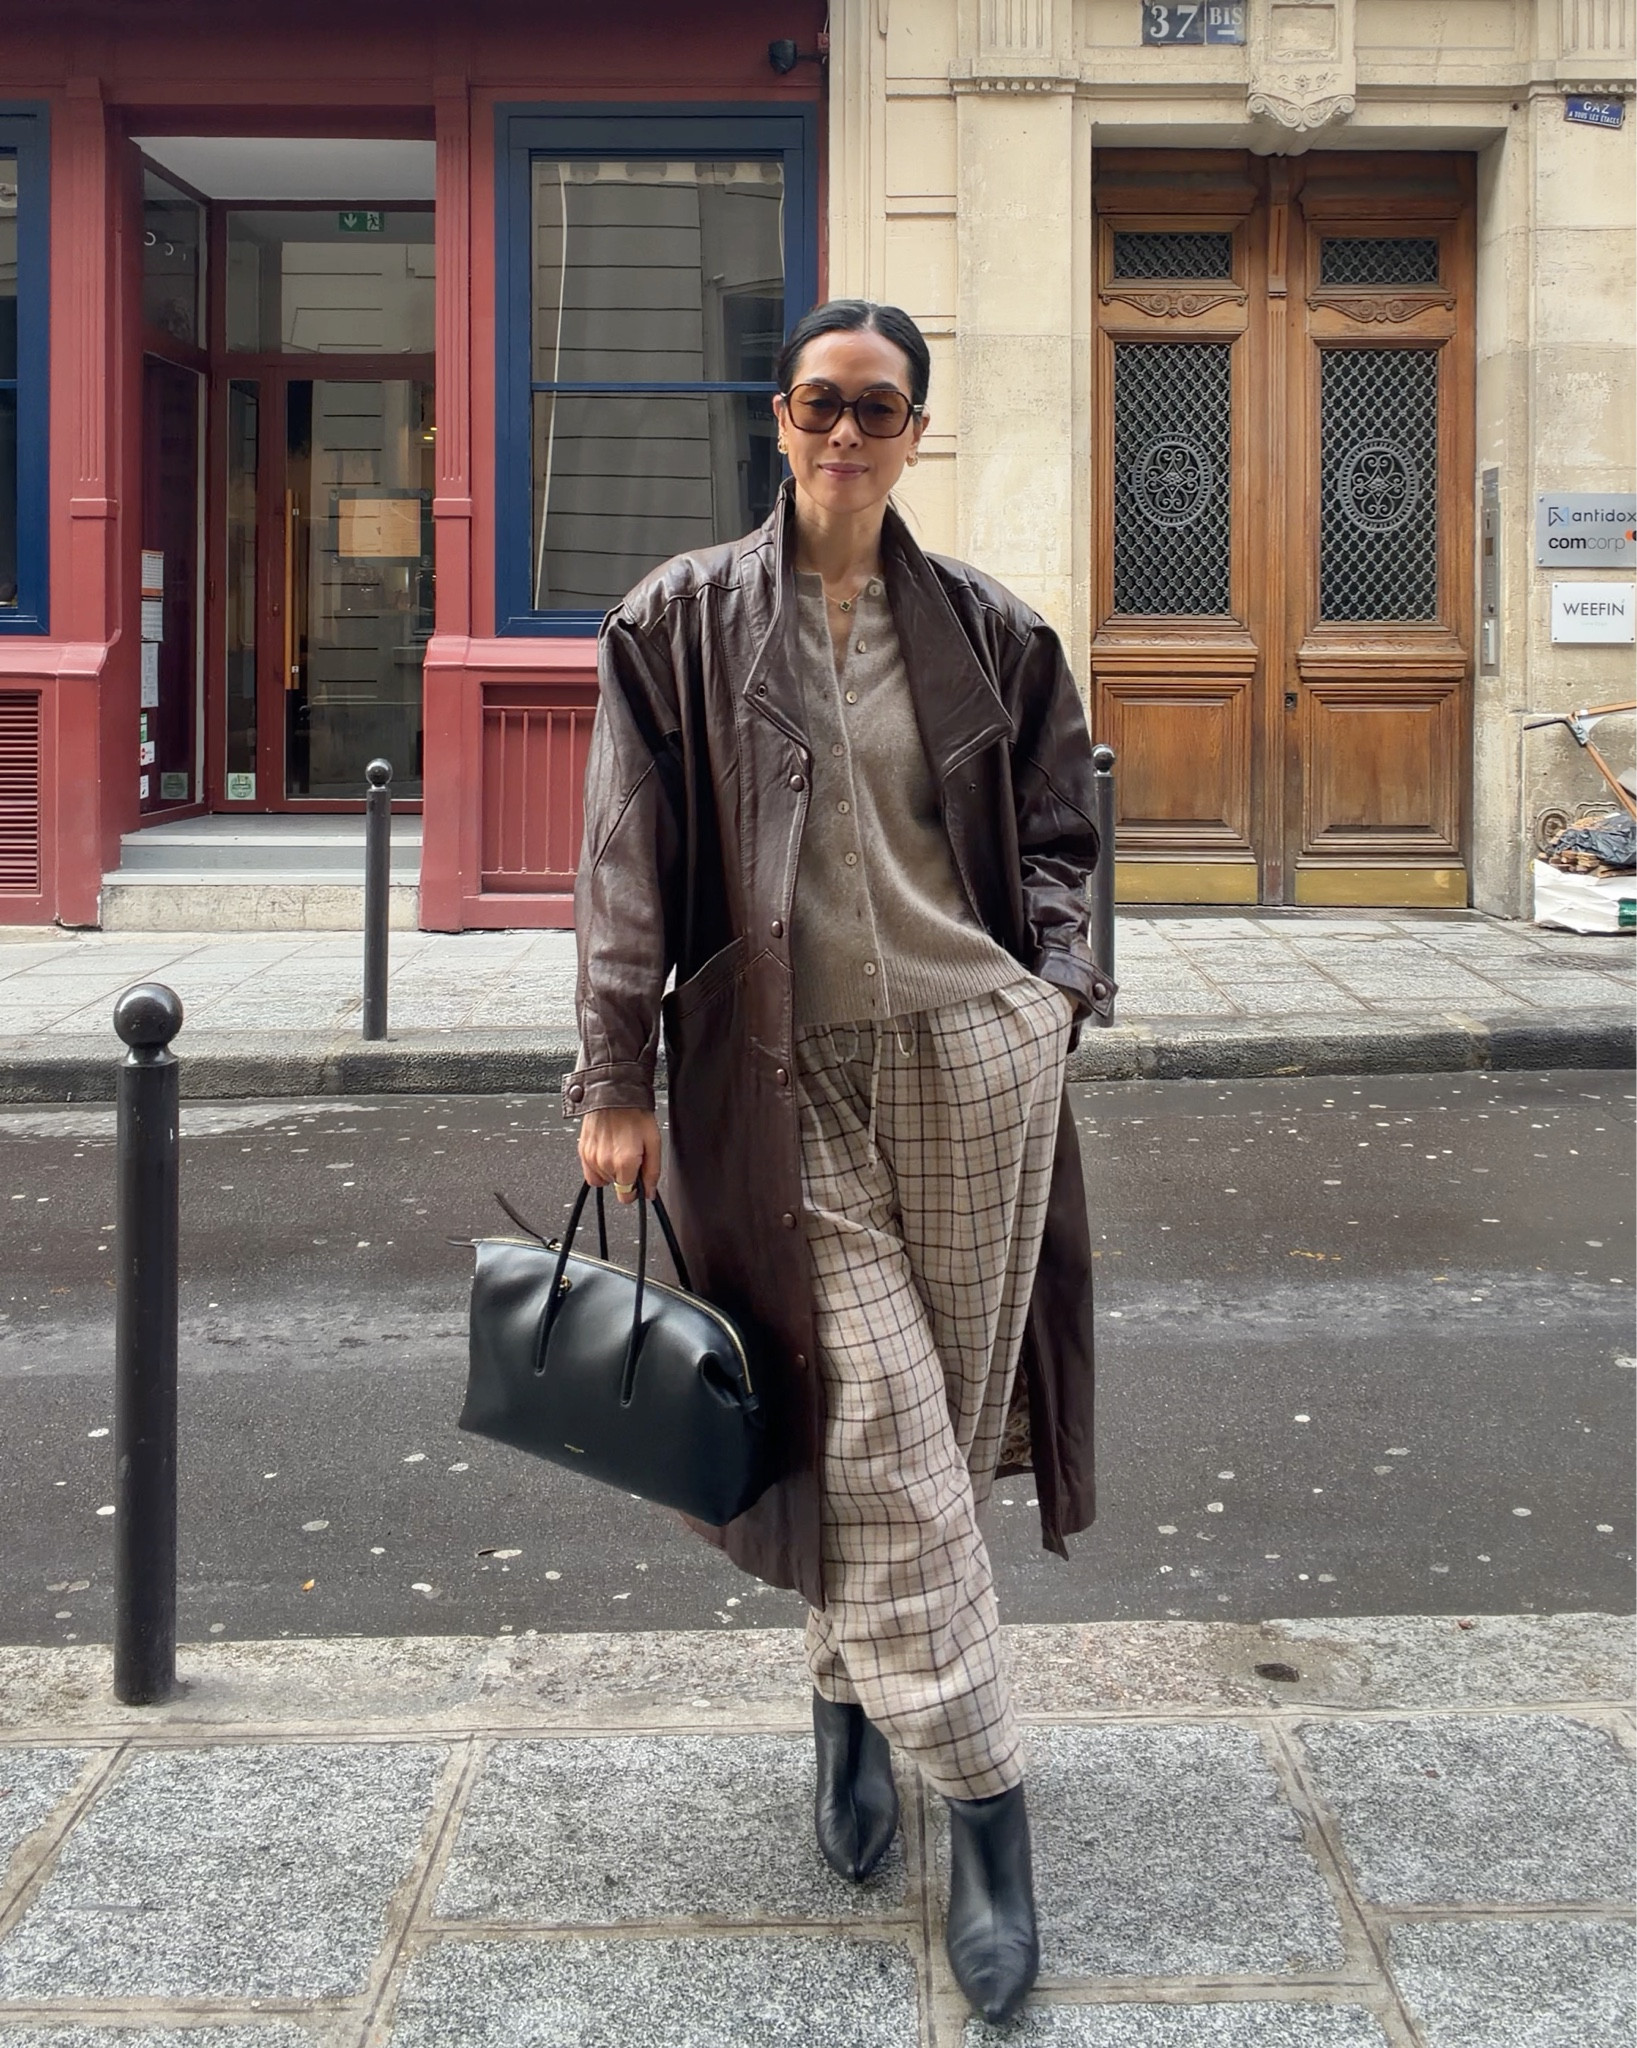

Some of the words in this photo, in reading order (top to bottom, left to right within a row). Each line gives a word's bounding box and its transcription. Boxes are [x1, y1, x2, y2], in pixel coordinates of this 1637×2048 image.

[1150, 5, 1198, 38] 37
[1210, 7, 1243, 25] BIS
[1583, 101, 1610, 115] GAZ
[1571, 508, 1637, 522] antidox
[1548, 537, 1626, 552] comcorp
[1563, 602, 1625, 616] WEEFIN
